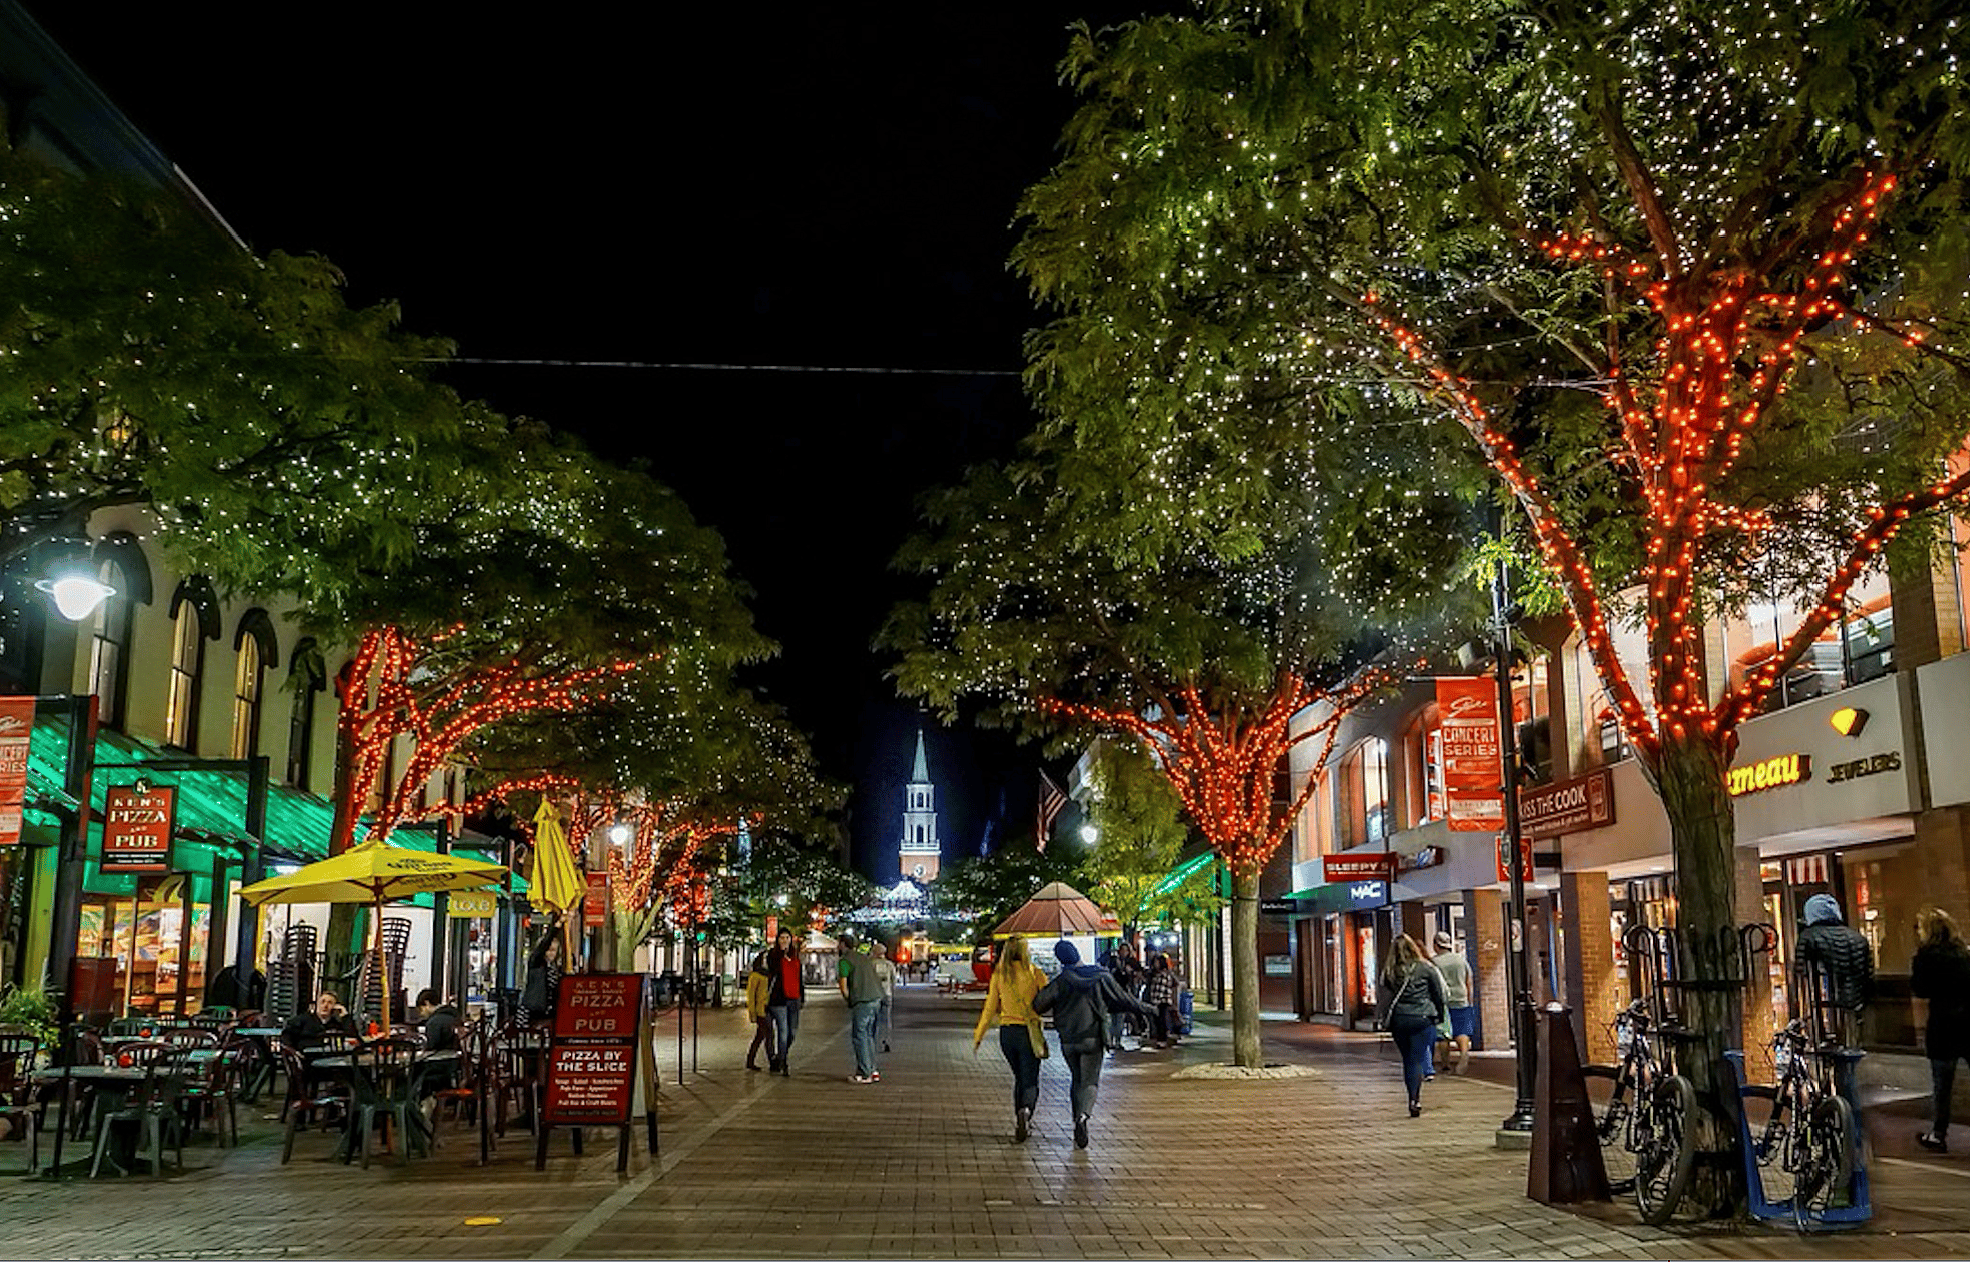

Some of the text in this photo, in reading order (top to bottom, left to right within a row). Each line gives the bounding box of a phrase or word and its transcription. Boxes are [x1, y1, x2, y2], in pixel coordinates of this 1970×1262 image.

[1444, 727, 1496, 744] CONCERT
[1444, 744, 1498, 756] SERIES
[1826, 751, 1902, 784] JEWELERS
[1536, 793, 1555, 816] THE
[1555, 783, 1588, 811] COOK
[109, 810, 167, 823] PIZZA
[115, 834, 158, 848] PUB
[1350, 882, 1382, 900] MAC
[570, 995, 625, 1007] PIZZA
[575, 1018, 617, 1032] PUB
[561, 1050, 623, 1061] PIZZA BY
[556, 1062, 627, 1072] THE SLICE
